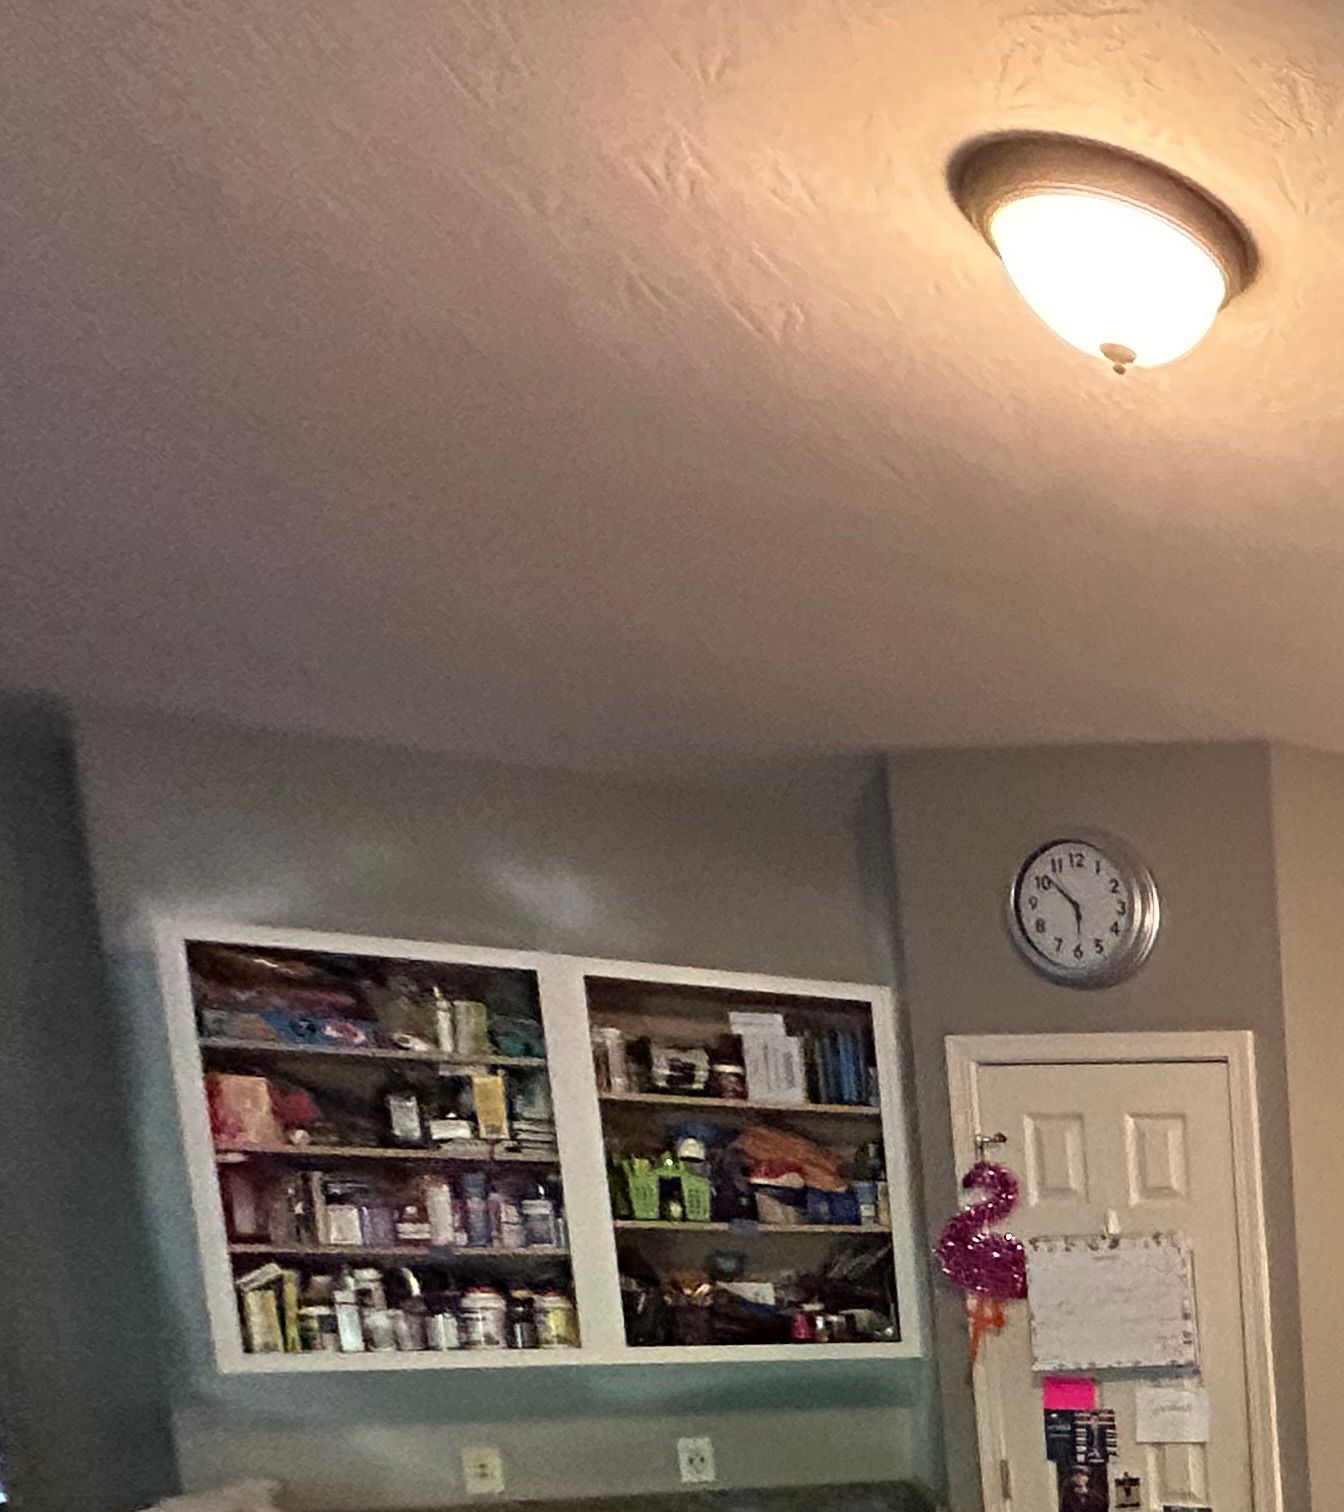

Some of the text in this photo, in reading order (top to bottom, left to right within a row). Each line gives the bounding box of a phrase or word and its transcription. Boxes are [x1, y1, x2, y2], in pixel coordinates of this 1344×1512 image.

[1051, 858, 1063, 873] 11
[1069, 852, 1085, 868] 12
[1094, 860, 1101, 875] 1
[1034, 874, 1052, 891] 10
[1109, 878, 1119, 893] 2
[1028, 896, 1038, 911] 9
[1116, 900, 1126, 916] 3
[1035, 918, 1046, 934] 8
[1110, 921, 1121, 937] 4
[1054, 937, 1064, 952] 7
[1073, 944, 1084, 960] 6
[1094, 938, 1104, 954] 5
